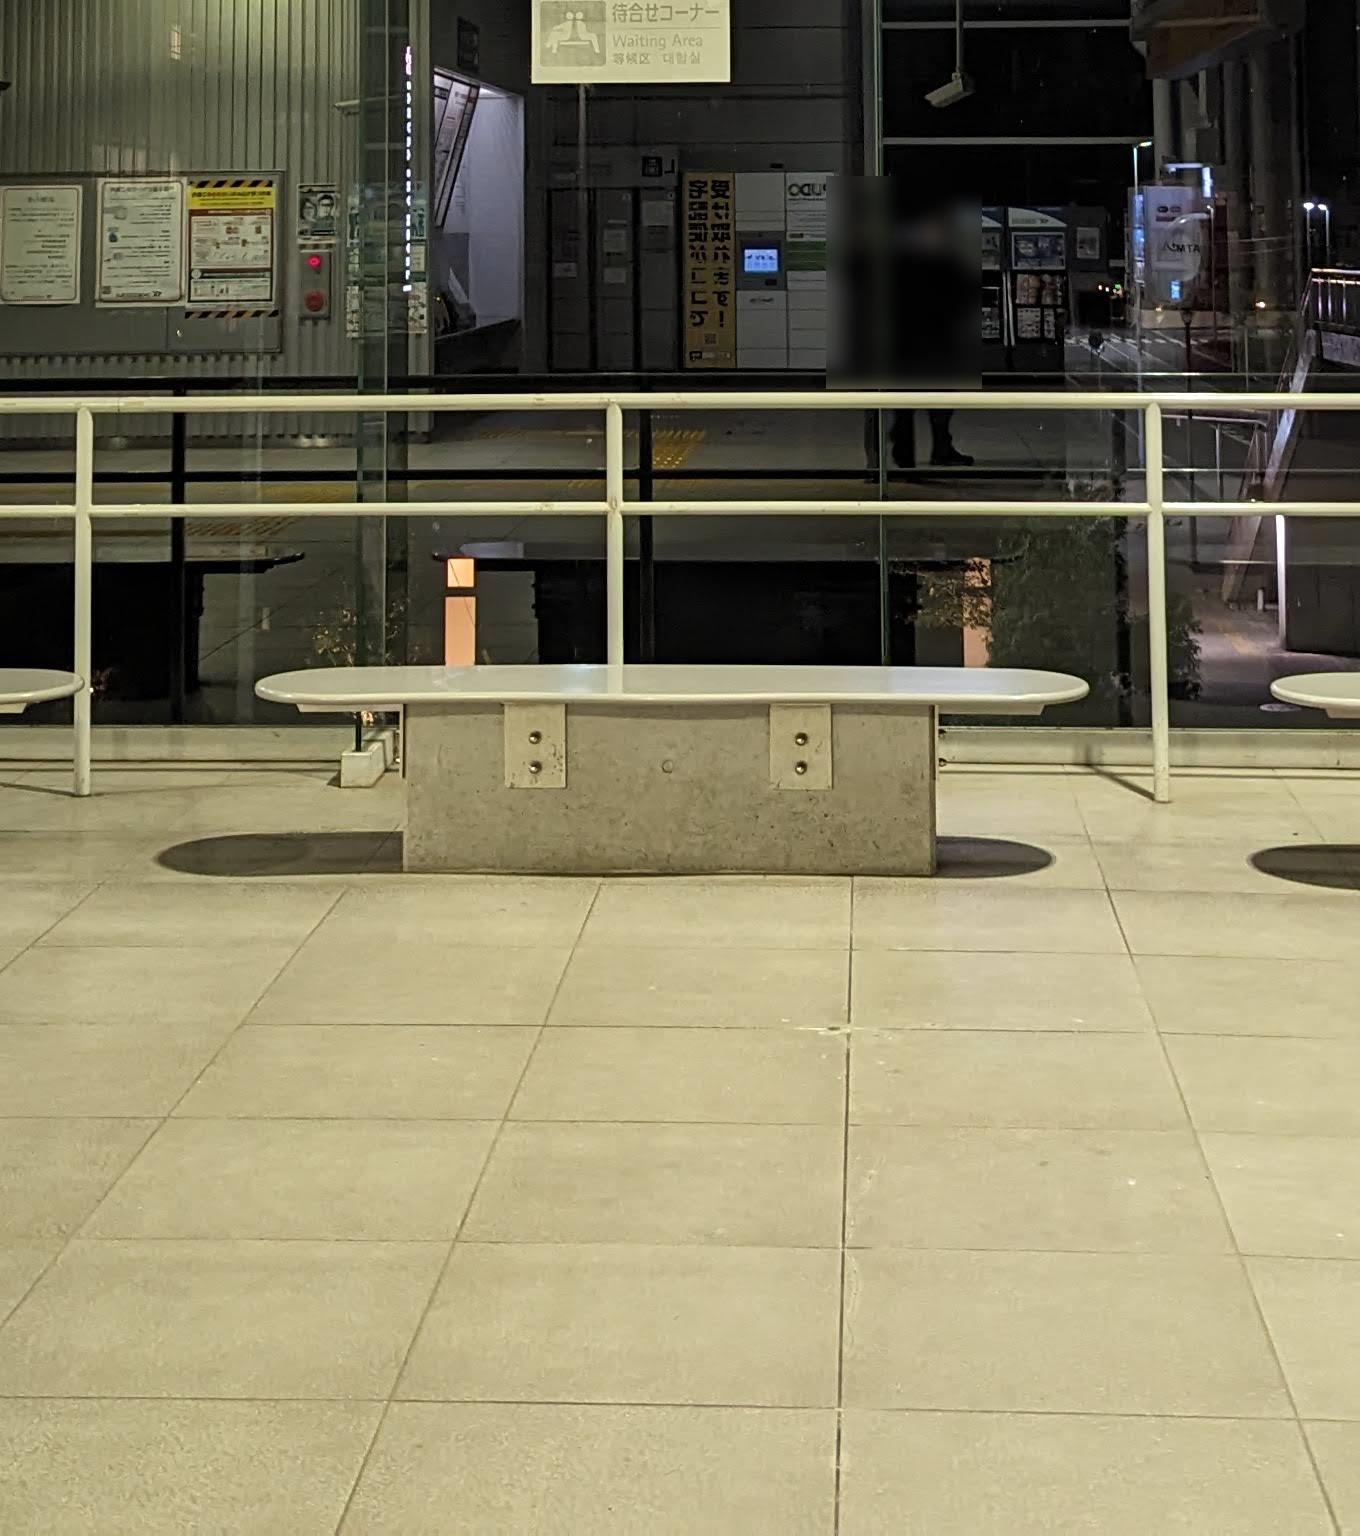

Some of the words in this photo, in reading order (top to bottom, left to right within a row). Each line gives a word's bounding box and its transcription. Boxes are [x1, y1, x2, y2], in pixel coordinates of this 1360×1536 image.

[611, 2, 720, 23] 待合せコーナー
[612, 33, 666, 51] Waiting
[672, 33, 704, 48] Area
